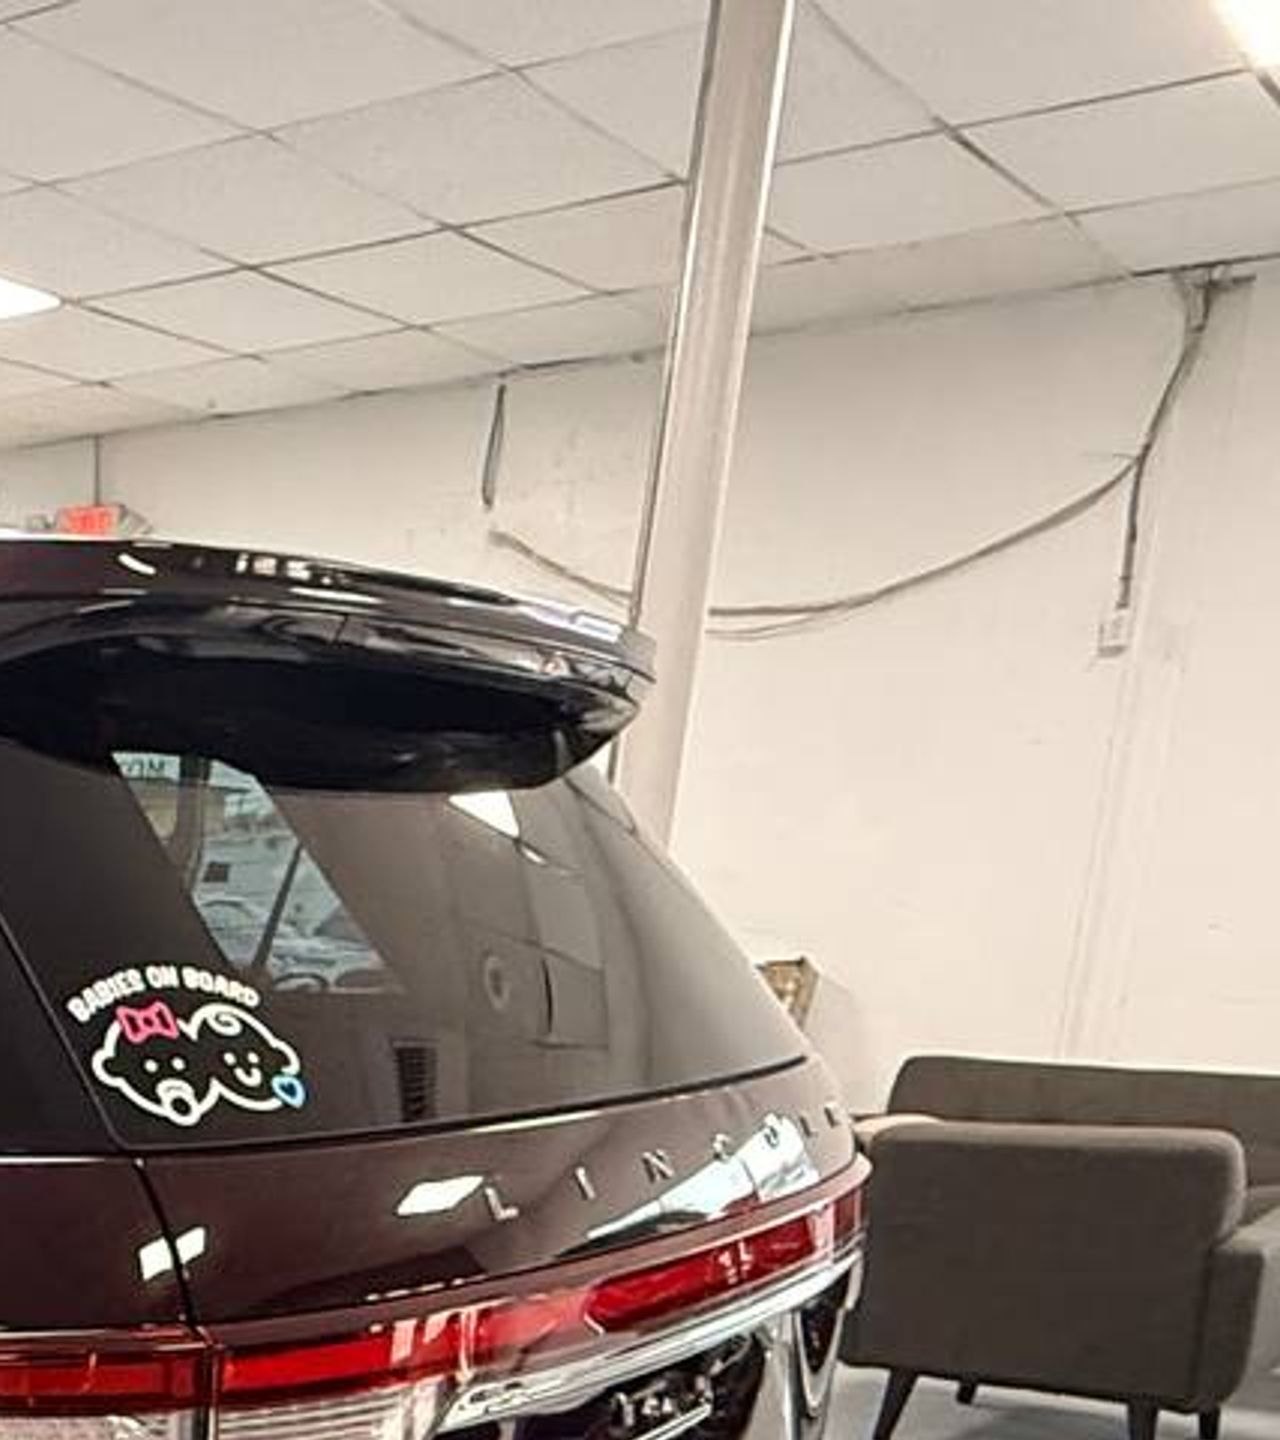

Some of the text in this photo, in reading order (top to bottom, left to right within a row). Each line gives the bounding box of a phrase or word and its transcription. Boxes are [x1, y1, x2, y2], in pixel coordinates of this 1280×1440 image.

[67, 965, 260, 1022] BABIES ON BOARD
